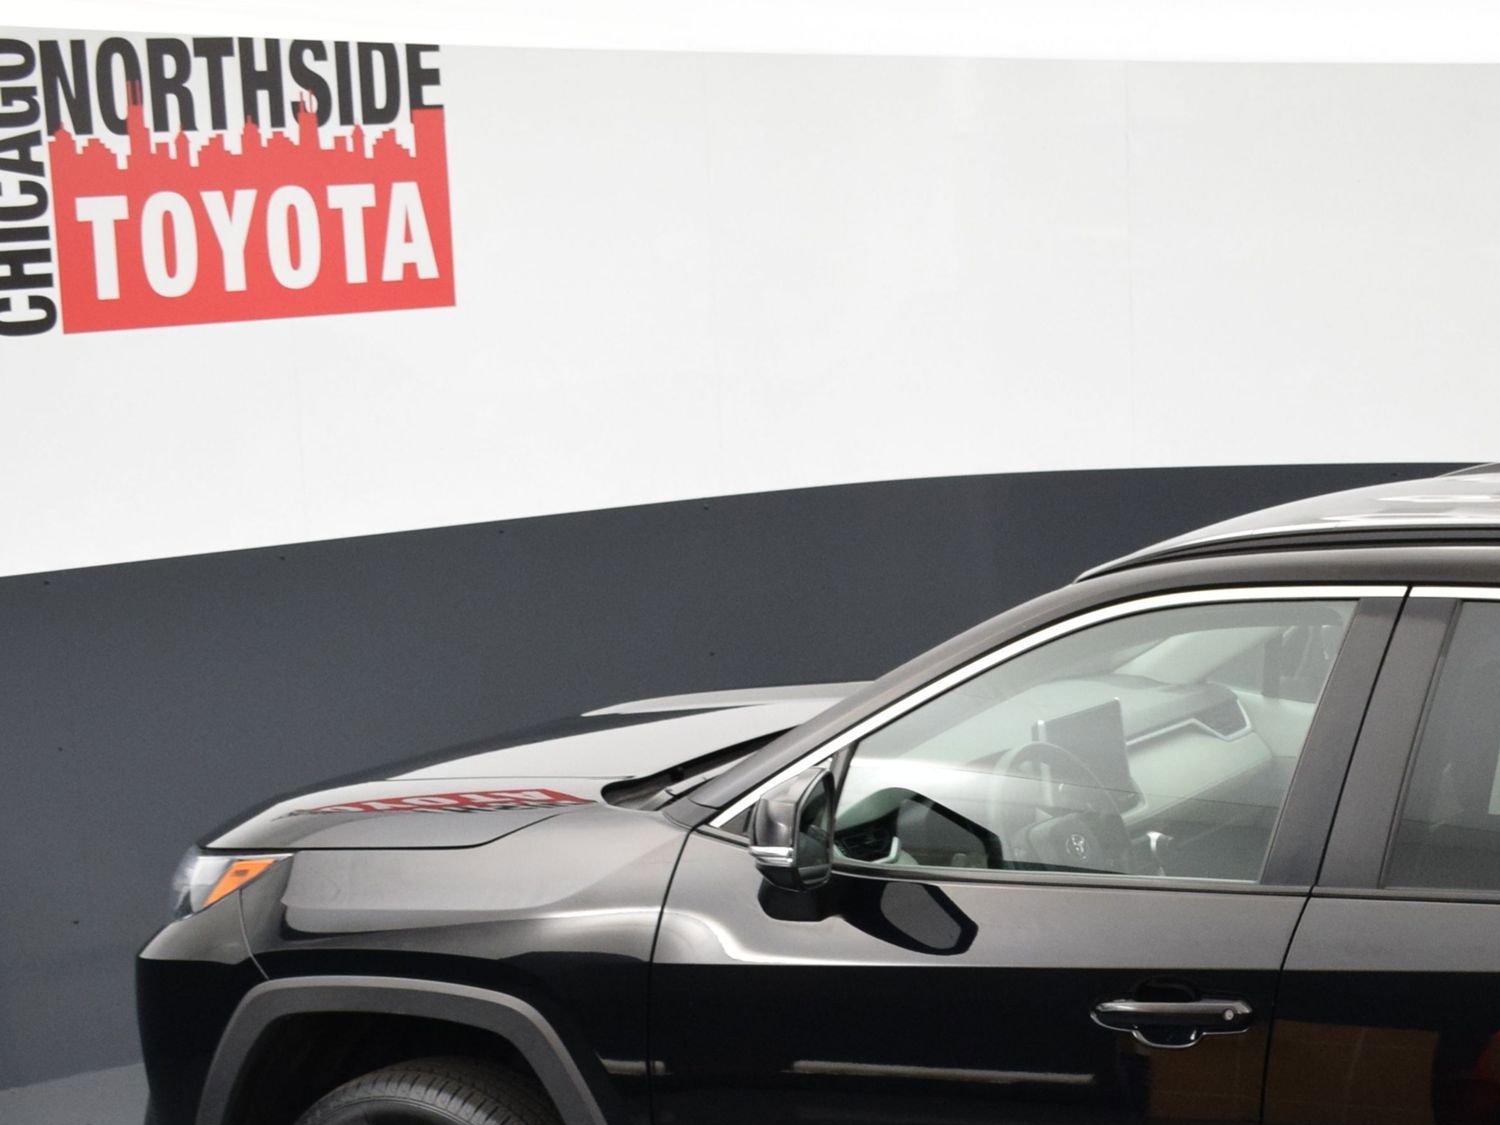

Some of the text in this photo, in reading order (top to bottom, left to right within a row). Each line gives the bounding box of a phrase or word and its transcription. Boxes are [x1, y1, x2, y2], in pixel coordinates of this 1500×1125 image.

[38, 37, 444, 137] NORTHSIDE
[0, 38, 57, 336] CHICAGO
[75, 181, 440, 300] TOYOTA
